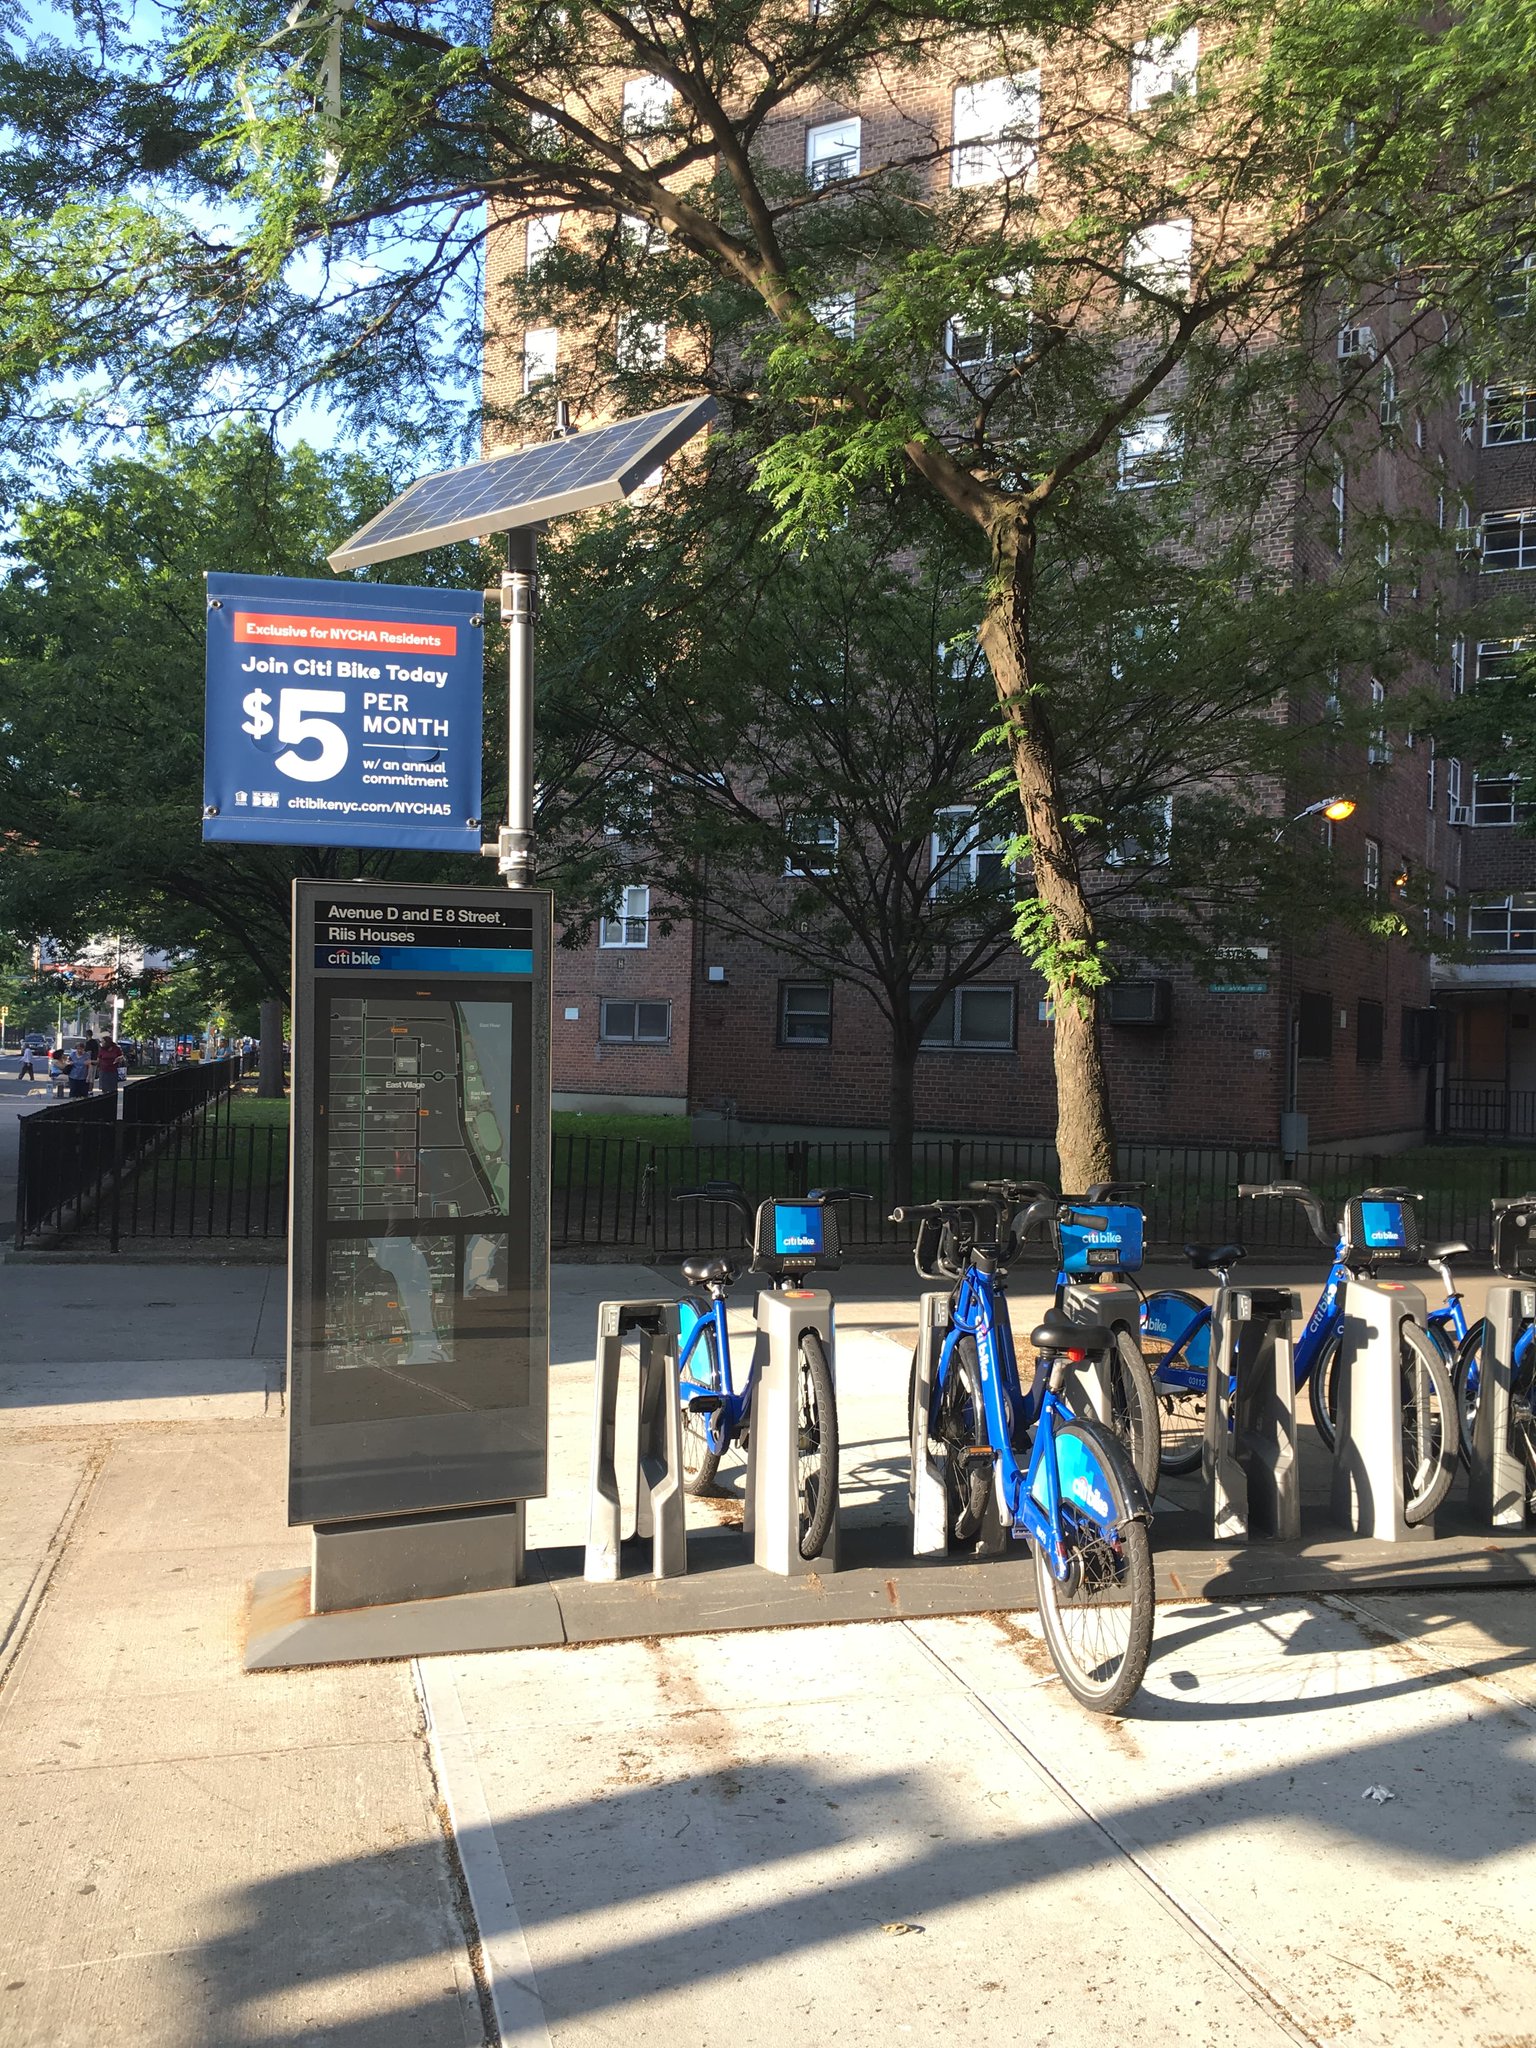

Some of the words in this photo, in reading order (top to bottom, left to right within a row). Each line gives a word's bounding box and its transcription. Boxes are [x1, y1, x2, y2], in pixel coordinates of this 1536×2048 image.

[246, 622, 308, 639] Exclusive
[310, 625, 329, 639] for
[330, 627, 378, 643] NYCHA
[379, 631, 441, 647] Residents
[241, 656, 289, 675] Join
[294, 658, 332, 677] Citi
[337, 661, 381, 680] Bike
[385, 664, 448, 688] Today
[363, 692, 409, 712] PER
[241, 687, 349, 783] $5
[363, 715, 449, 737] MONTH
[362, 758, 380, 770] w/
[382, 761, 400, 772] an
[402, 761, 446, 774] annual
[362, 774, 449, 788] commitment
[287, 797, 452, 816] citibikenyc.com/NYCHA5
[327, 904, 384, 920] Avenue
[386, 907, 399, 920] D
[402, 908, 430, 921] and
[432, 909, 443, 921] E
[446, 909, 456, 922] 8
[458, 909, 501, 924] Street
[328, 927, 356, 941] Riis
[360, 928, 415, 943] Houses
[386, 1081, 402, 1089] East
[403, 1081, 425, 1090] Village
[1188, 1376, 1206, 1387] 03112
